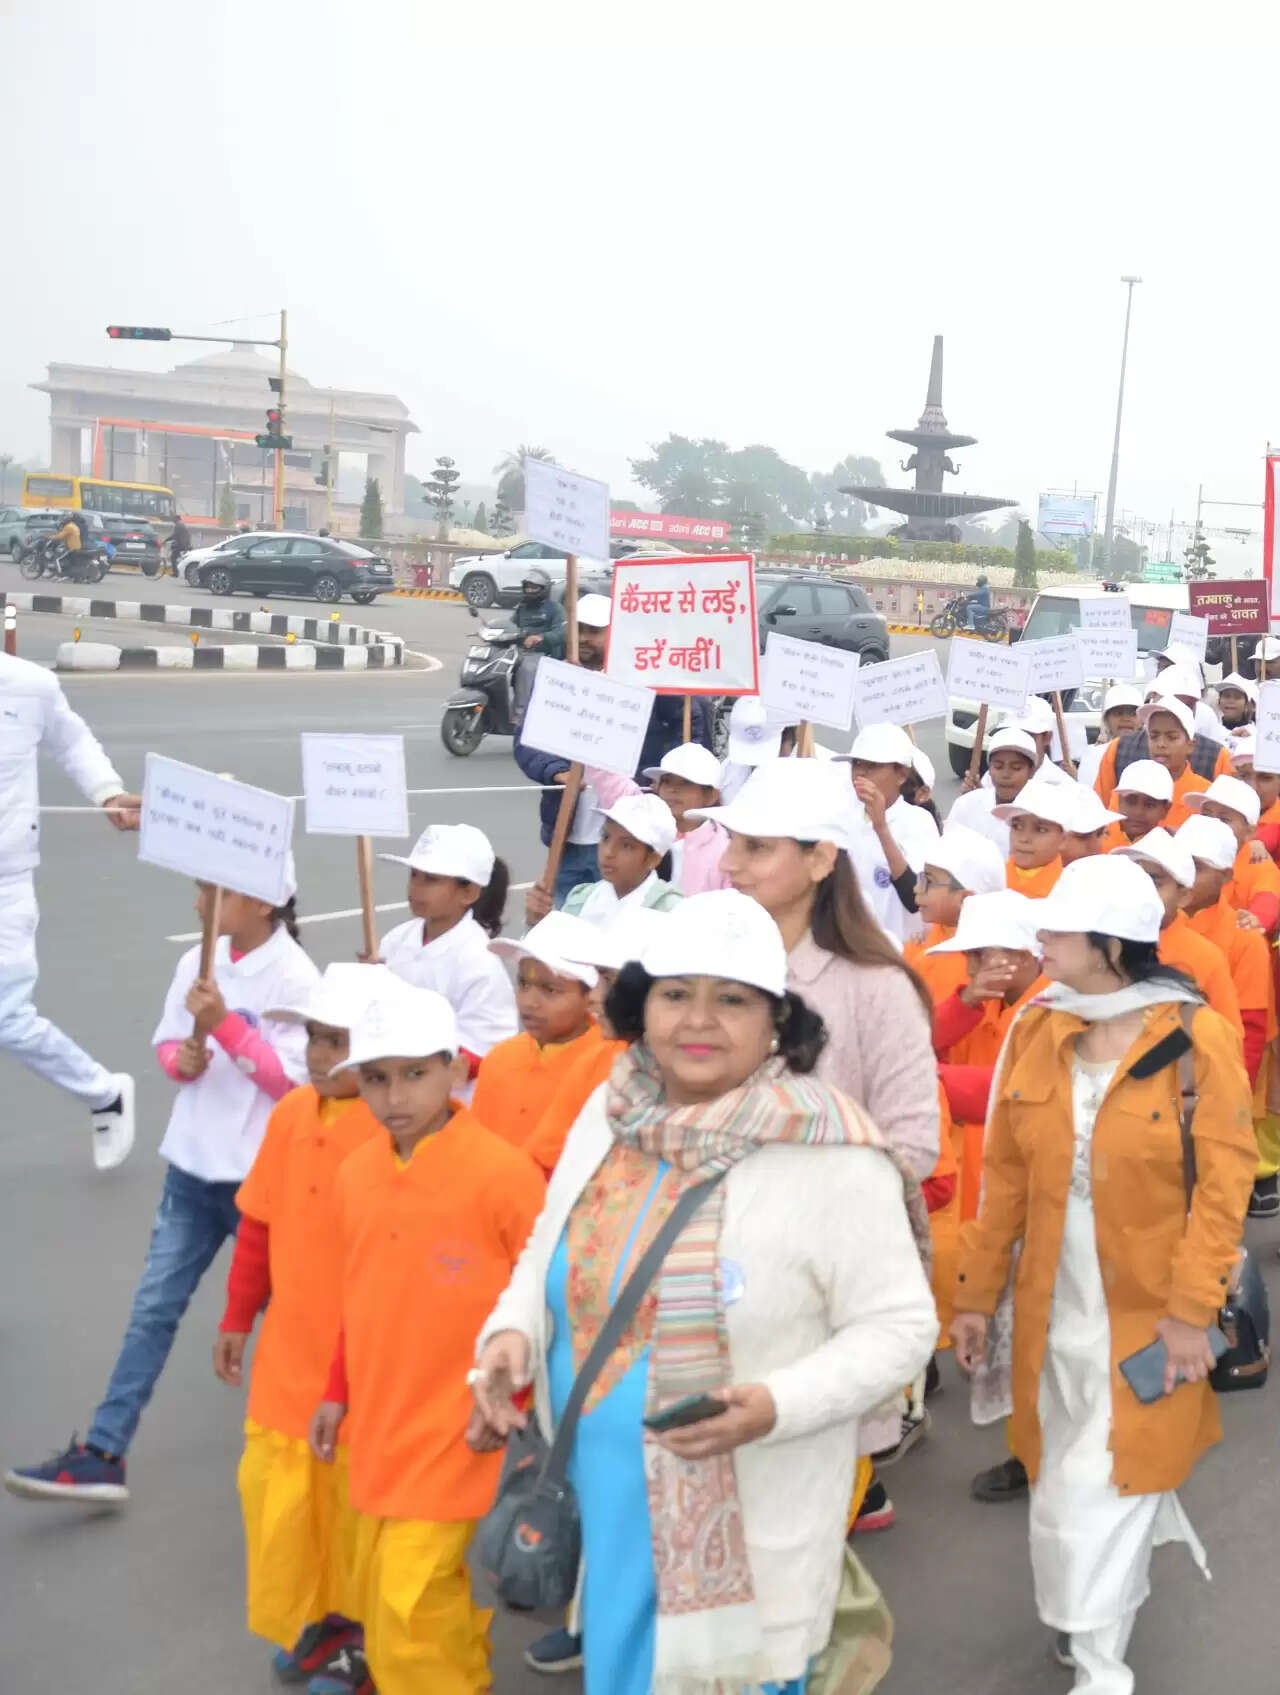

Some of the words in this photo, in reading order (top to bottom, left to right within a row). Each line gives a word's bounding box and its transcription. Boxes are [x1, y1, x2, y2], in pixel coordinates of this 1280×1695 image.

[620, 582, 673, 613] कैंसर
[678, 581, 696, 613] से
[634, 638, 667, 671] डरें
